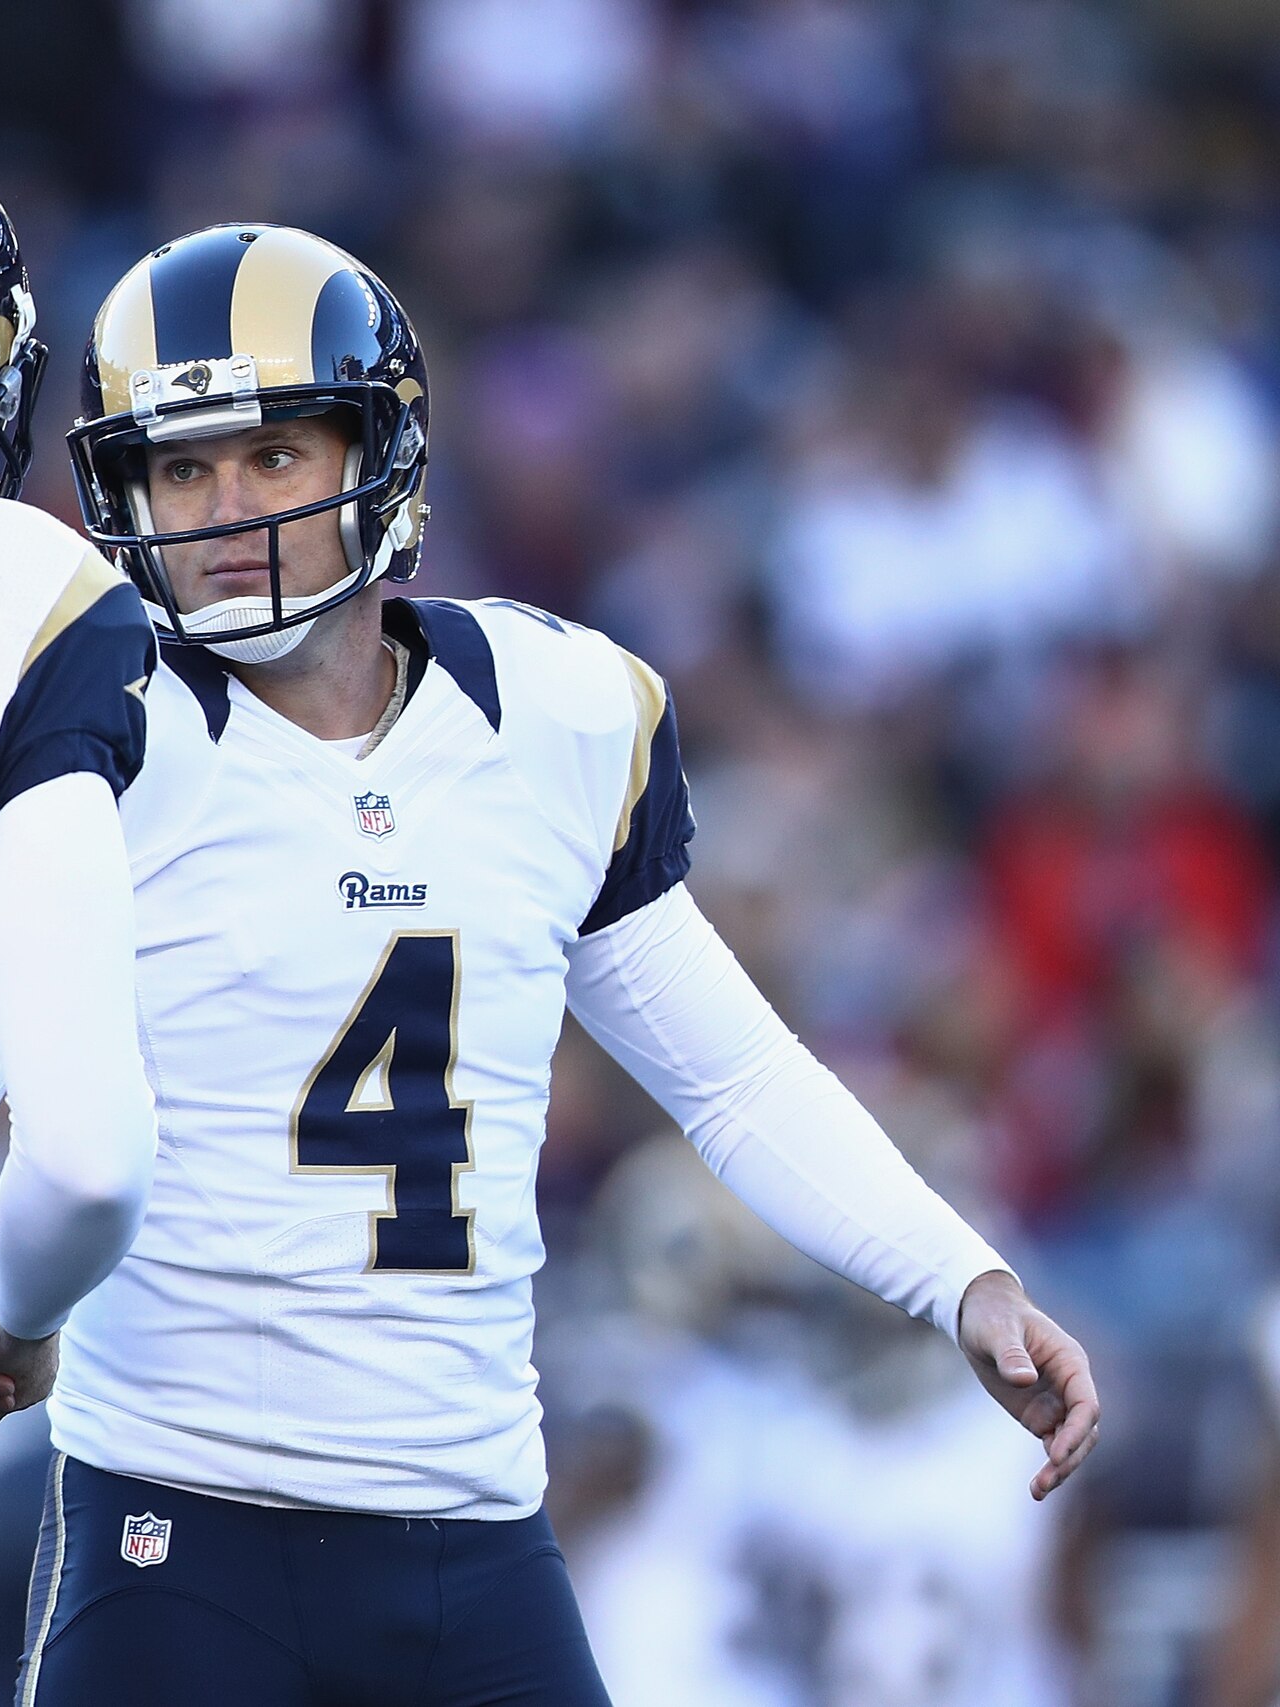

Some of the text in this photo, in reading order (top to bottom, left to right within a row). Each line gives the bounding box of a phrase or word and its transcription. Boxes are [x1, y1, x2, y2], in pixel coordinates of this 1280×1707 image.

[360, 810, 392, 832] NFL
[339, 871, 428, 908] Rams
[289, 928, 477, 1275] 4
[128, 1535, 161, 1559] NFL
